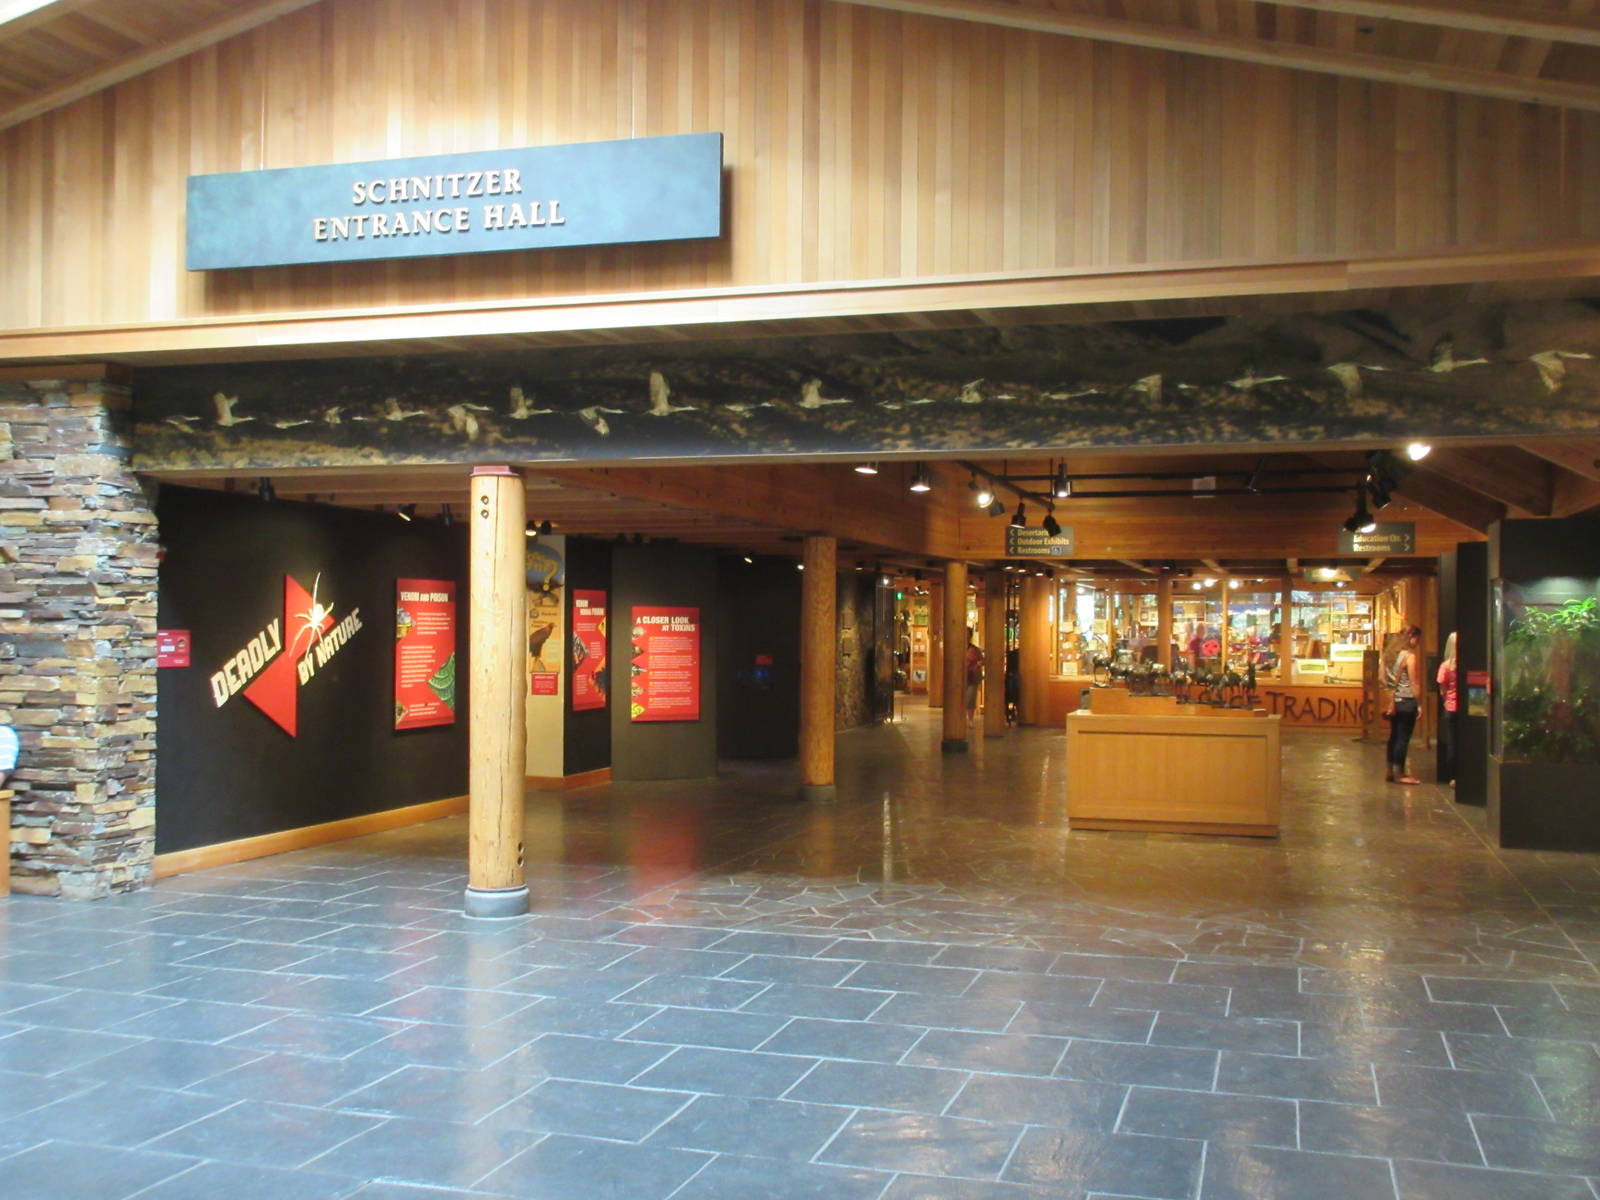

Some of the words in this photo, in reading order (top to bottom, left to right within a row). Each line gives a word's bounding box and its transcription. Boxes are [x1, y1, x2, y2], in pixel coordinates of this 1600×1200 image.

[352, 168, 523, 205] SCHNITZER
[313, 207, 470, 242] ENTRANCE
[483, 200, 566, 231] HALL
[1017, 537, 1043, 545] Outdoor
[1044, 537, 1070, 545] Exhibits
[1353, 534, 1389, 543] Education
[1017, 546, 1051, 554] Restrooms
[1353, 543, 1392, 552] Restrooms
[636, 616, 642, 625] A
[642, 615, 670, 625] CLOSER
[671, 616, 690, 625] LOOK
[671, 623, 696, 632] TOXINS
[297, 653, 315, 686] BY
[315, 607, 363, 668] NATURE
[210, 618, 282, 708] DEADLY
[1265, 690, 1375, 724] TRADING
